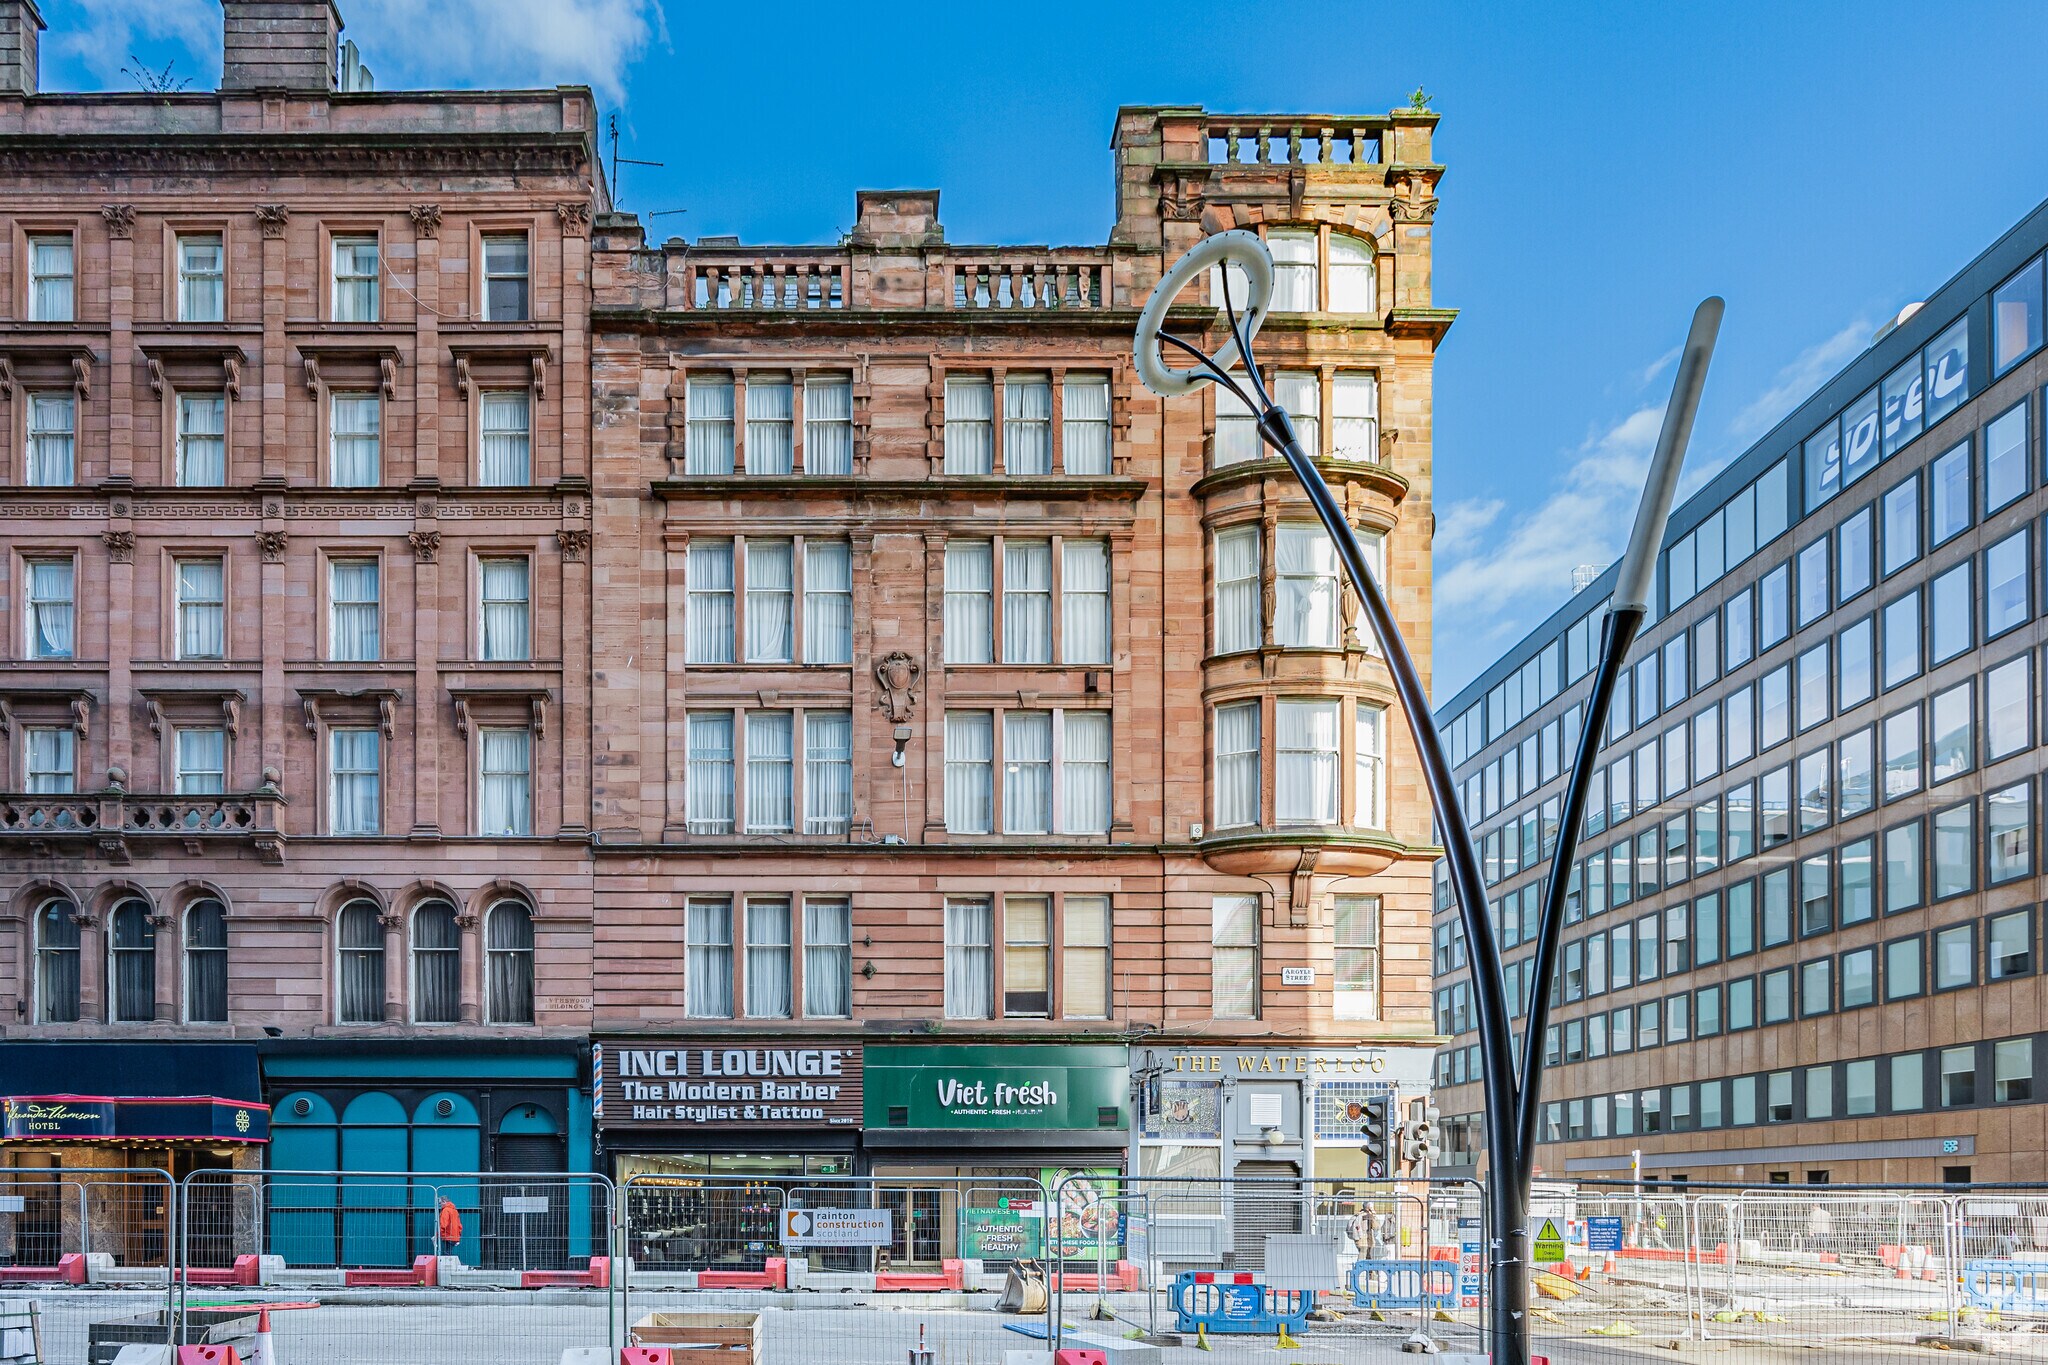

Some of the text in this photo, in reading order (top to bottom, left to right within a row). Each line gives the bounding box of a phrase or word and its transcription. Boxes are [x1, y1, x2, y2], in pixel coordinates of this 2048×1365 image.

[618, 1050, 842, 1077] INCI LOUNGE
[1173, 1056, 1386, 1073] THE WATERLOO
[621, 1081, 840, 1101] The Modern Barber
[938, 1078, 988, 1106] Viet
[46, 1104, 100, 1120] Thomson
[633, 1105, 824, 1122] Hair Stylist & Tattoo
[816, 1220, 884, 1228] construction
[816, 1230, 859, 1238] scotland
